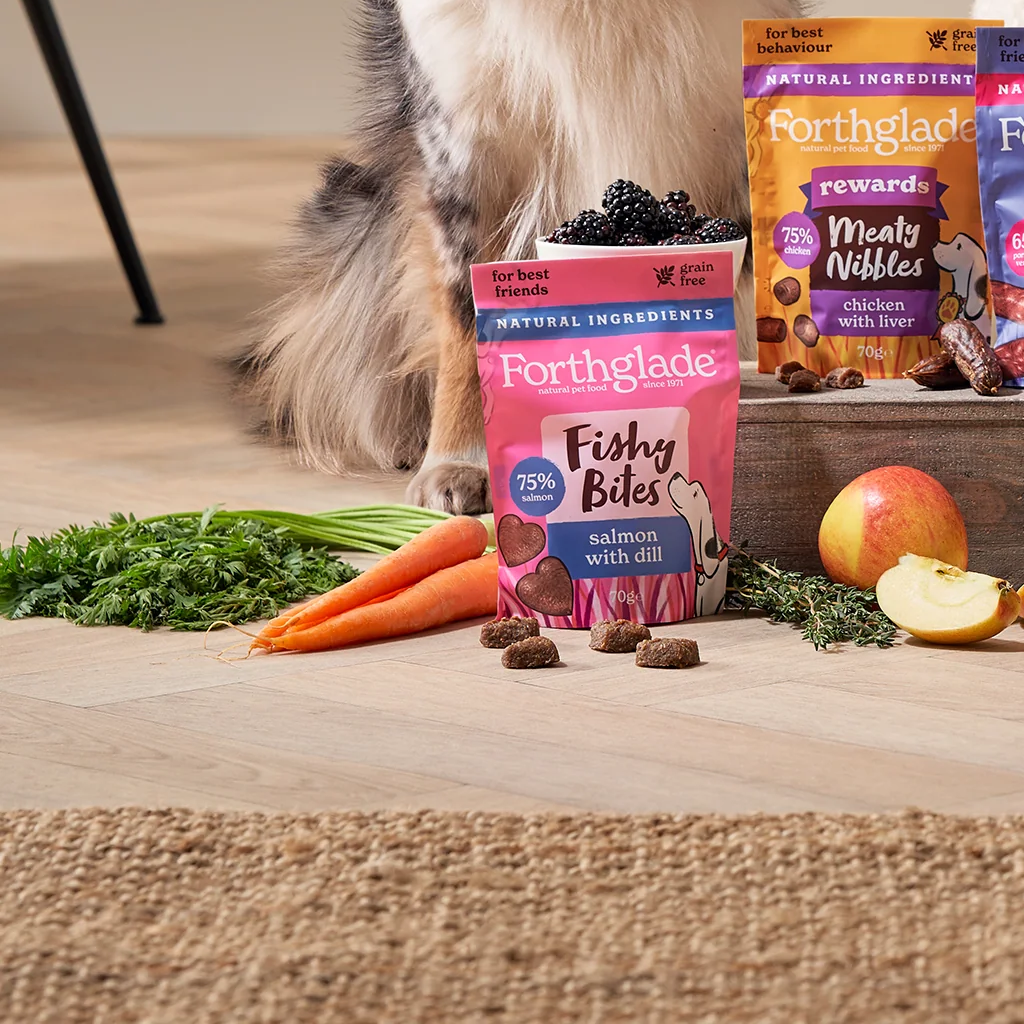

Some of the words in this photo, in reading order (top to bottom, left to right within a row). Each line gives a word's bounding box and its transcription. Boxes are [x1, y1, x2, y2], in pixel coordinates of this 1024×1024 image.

[766, 28, 787, 39] for
[791, 27, 823, 38] best
[953, 28, 976, 41] grai
[757, 42, 833, 54] behaviour
[953, 41, 976, 52] free
[999, 36, 1020, 47] for
[766, 74, 851, 85] NATURAL
[860, 73, 973, 85] INGREDIENT
[769, 108, 976, 156] Forthglade
[800, 144, 831, 152] natural
[833, 145, 846, 153] pet
[819, 175, 929, 195] rewards
[781, 227, 813, 245] 75%
[829, 215, 920, 248] Meaty
[784, 246, 811, 256] chicken
[680, 262, 714, 275] grain
[826, 247, 924, 281] Nibbles
[492, 270, 514, 282] for
[518, 268, 550, 281] best
[680, 275, 706, 286] free
[495, 284, 548, 298] friends
[843, 299, 905, 311] chicken
[496, 316, 580, 329] NATURAL
[589, 309, 714, 326] INGREDIENTS
[838, 315, 876, 328] with
[879, 315, 915, 327] liver
[499, 344, 717, 393] Forthglade
[538, 386, 570, 395] natural
[572, 386, 586, 395] pet
[587, 383, 607, 392] food
[643, 381, 665, 389] since
[667, 379, 684, 387] 1971
[563, 421, 675, 473] Fishy
[517, 473, 556, 491] 75%
[582, 464, 661, 513] Bites
[522, 493, 553, 502] salmon
[589, 528, 658, 545] salmon
[585, 549, 629, 565] with
[634, 546, 662, 563] dill
